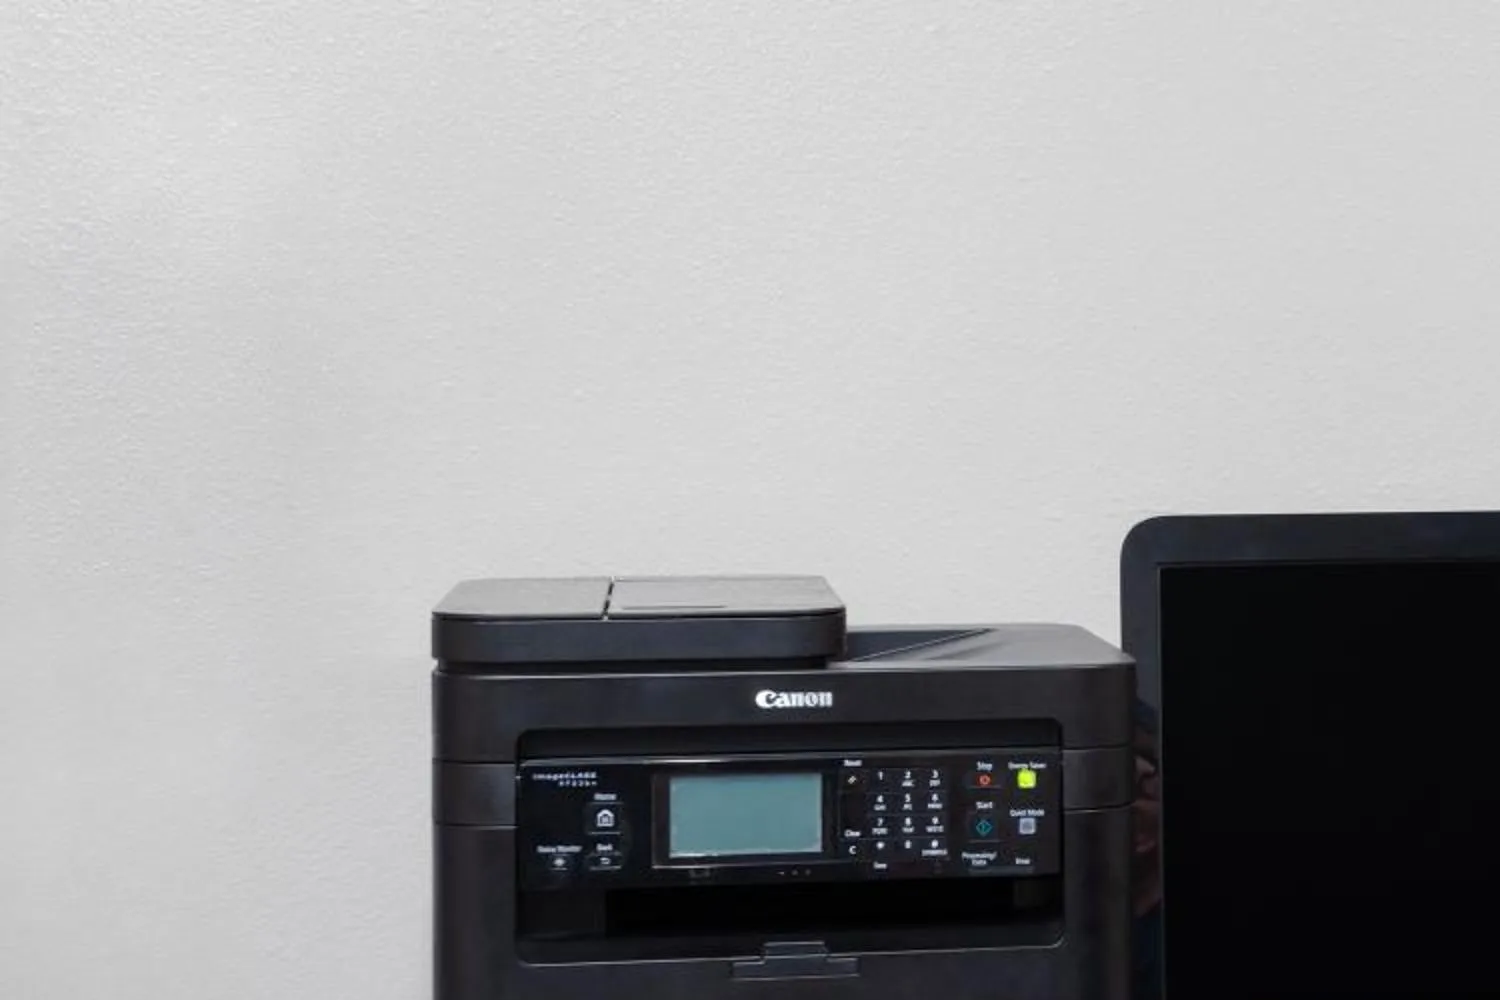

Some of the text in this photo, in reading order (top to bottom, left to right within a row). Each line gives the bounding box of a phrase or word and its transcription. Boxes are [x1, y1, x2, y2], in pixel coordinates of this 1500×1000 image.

[755, 690, 833, 709] Canon
[878, 771, 883, 780] 1
[848, 845, 857, 855] C
